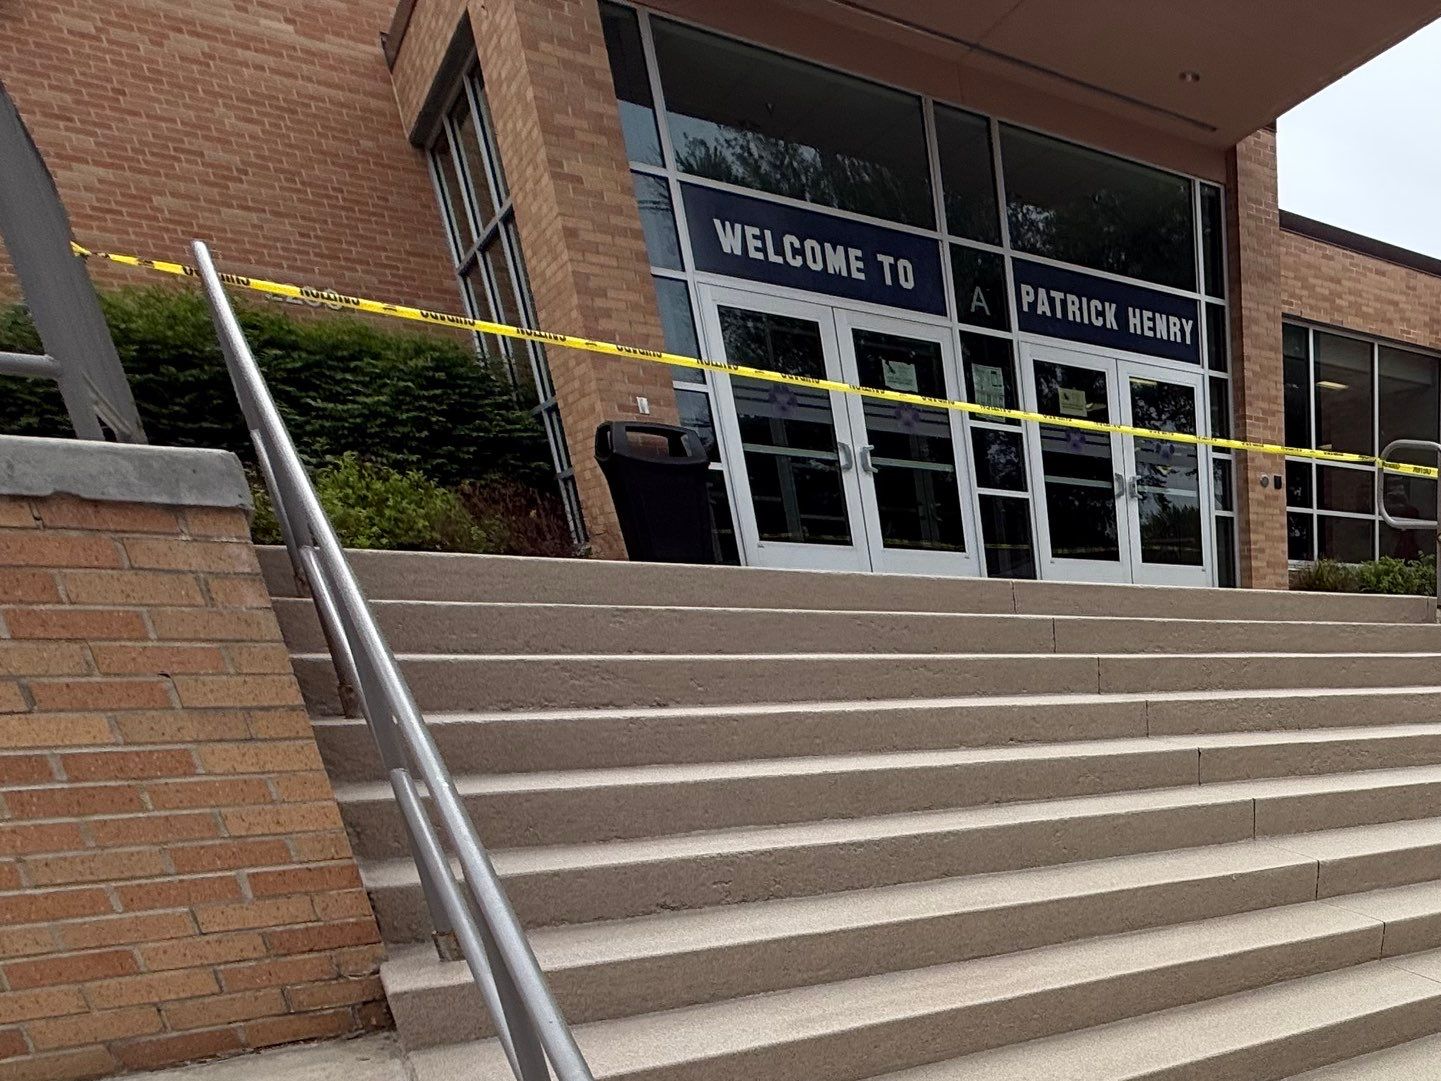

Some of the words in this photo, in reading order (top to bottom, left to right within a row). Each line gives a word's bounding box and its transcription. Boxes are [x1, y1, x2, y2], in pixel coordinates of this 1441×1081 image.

[713, 218, 866, 281] WELCOME
[877, 253, 915, 290] TO
[970, 286, 991, 316] A
[1020, 284, 1119, 331] PATRICK
[1128, 306, 1194, 345] HENRY
